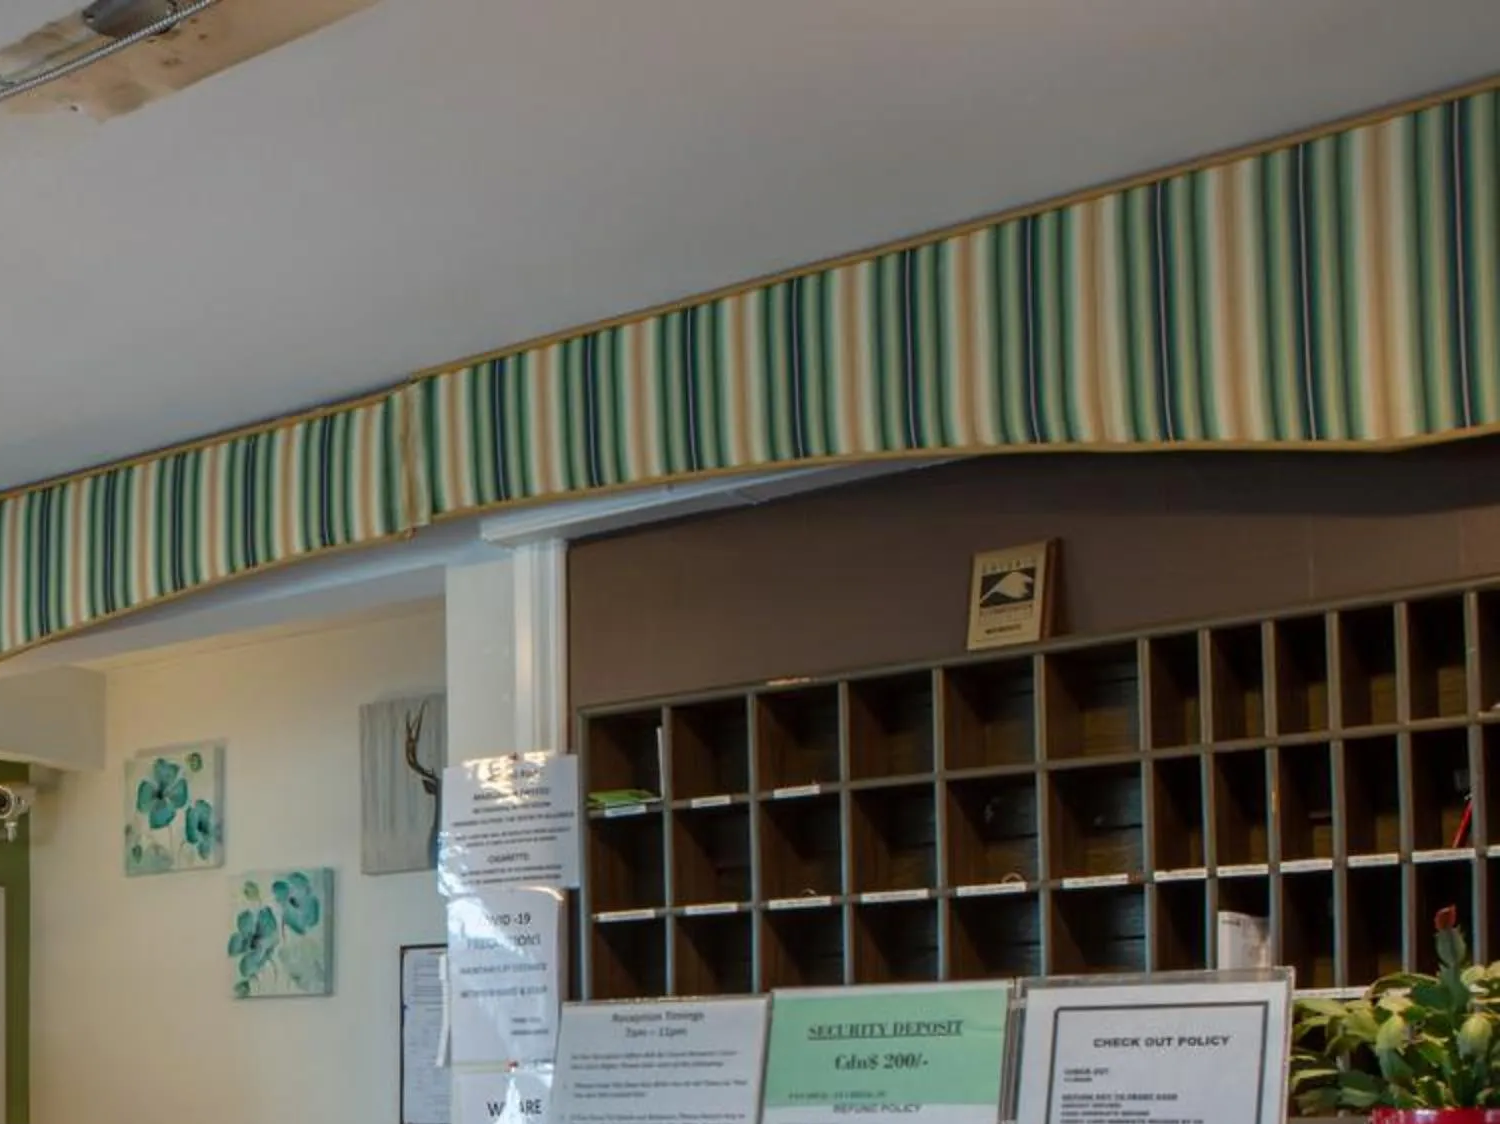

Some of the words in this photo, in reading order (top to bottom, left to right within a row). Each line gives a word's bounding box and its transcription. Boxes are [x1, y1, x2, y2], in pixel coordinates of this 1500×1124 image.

[807, 1022, 888, 1040] SECURITY
[893, 1019, 964, 1037] DEPOSIT
[1093, 1037, 1141, 1048] CHECK
[1144, 1036, 1173, 1047] OUT
[1178, 1035, 1230, 1047] POLICY
